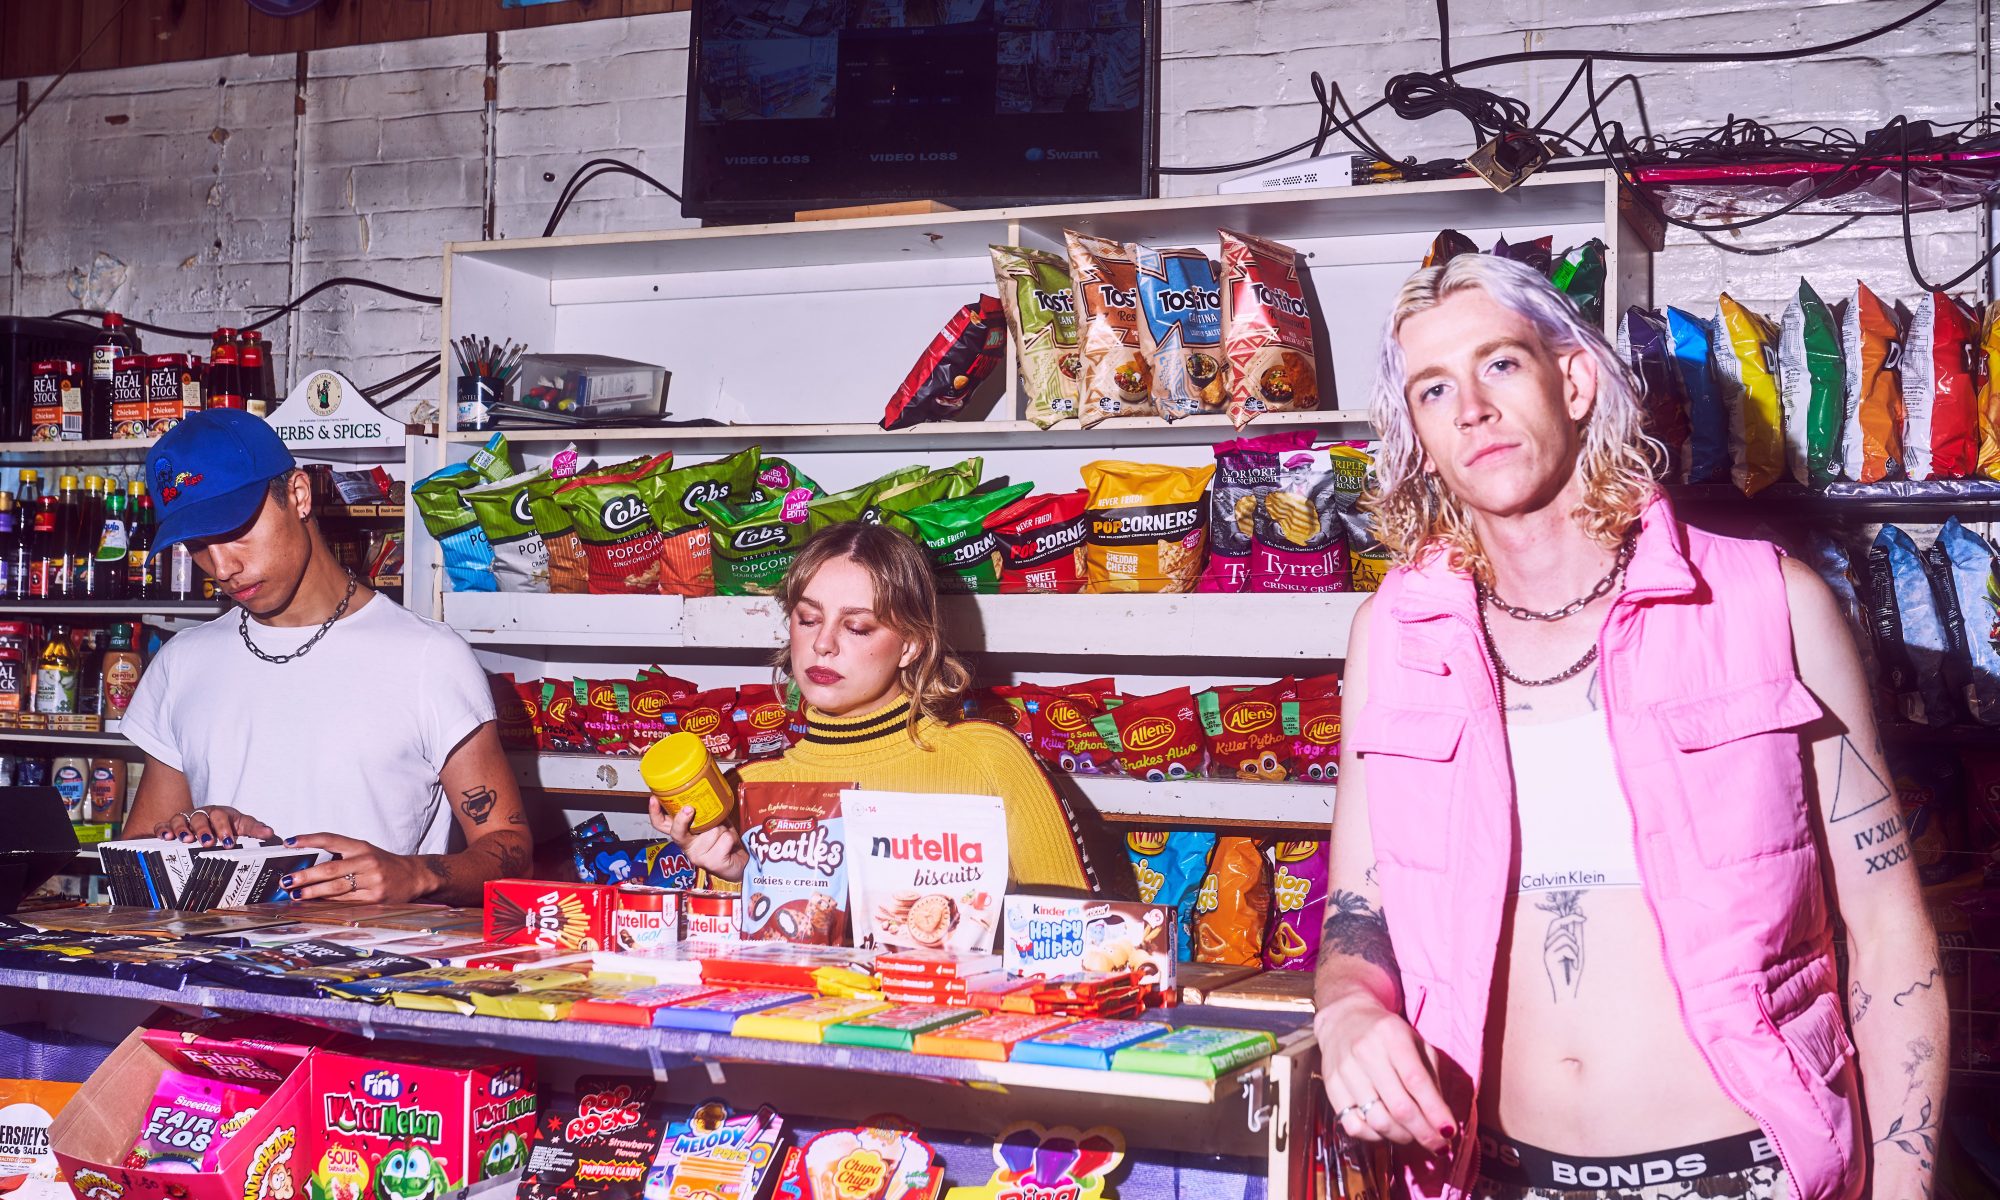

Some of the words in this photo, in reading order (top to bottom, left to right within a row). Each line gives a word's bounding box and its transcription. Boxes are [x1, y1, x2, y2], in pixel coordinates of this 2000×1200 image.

[725, 155, 769, 164] VIDEO
[773, 155, 810, 164] LOSS
[870, 153, 915, 162] VIDEO
[920, 152, 958, 161] LOSS
[1046, 148, 1099, 159] Swann
[33, 379, 57, 392] REAL
[114, 374, 141, 388] REAL
[151, 371, 178, 386] REAL
[33, 392, 57, 403] STOCK
[114, 388, 141, 400] STOCK
[151, 386, 178, 398] STOCK
[35, 411, 56, 420] Chicken
[116, 408, 139, 416] Chicken
[152, 406, 176, 415] Chicken
[318, 425, 330, 439] &
[334, 423, 381, 439] SPICES
[1097, 496, 1118, 507] NEVER
[1121, 496, 1143, 505] FRIED!
[1016, 520, 1034, 533] NEVER
[1034, 513, 1052, 526] FRIED!
[1093, 509, 1198, 534] POPCORNERS
[735, 526, 786, 547] Cobs
[947, 530, 967, 545] FRIED!
[743, 550, 781, 561] NATURAL
[1106, 553, 1138, 564] CHEDDAR
[1106, 562, 1138, 573] CHEESE
[1025, 571, 1056, 583] SWEET
[1263, 580, 1308, 592] CRINKLY
[1310, 581, 1343, 593] CRISPS
[685, 713, 718, 732] Allen's
[754, 708, 786, 727] Allen's
[1231, 708, 1273, 728] Allen's
[1130, 722, 1173, 746] Allen's
[1041, 737, 1065, 750] Killer
[1067, 739, 1107, 754] Pythons
[1165, 742, 1198, 760] Alive
[1216, 741, 1248, 755] Killer
[776, 820, 812, 831] ARNOTT'S
[871, 832, 983, 864] nutella
[794, 878, 829, 887] cream
[914, 866, 984, 887] biscuits
[1521, 871, 1567, 888] Calvin
[1569, 869, 1605, 884] Klein
[1033, 903, 1065, 916] kinder
[618, 912, 659, 928] utella
[689, 917, 730, 934] utella
[363, 1071, 400, 1098] Fini
[491, 1067, 521, 1096] Fini
[565, 1101, 641, 1143] ROCKS
[0, 1125, 49, 1147] ERSHEY'S
[675, 1128, 746, 1154] MELODY
[608, 1137, 655, 1152] Strawberry
[327, 1149, 359, 1167] SOUR
[614, 1148, 642, 1158] Flavour
[712, 1147, 749, 1161] POPS
[580, 1164, 615, 1177] POPPING
[615, 1166, 643, 1178] CANDY
[844, 1158, 882, 1175] Chupa
[1552, 1152, 1708, 1188] BONDS
[838, 1173, 876, 1188] Chups
